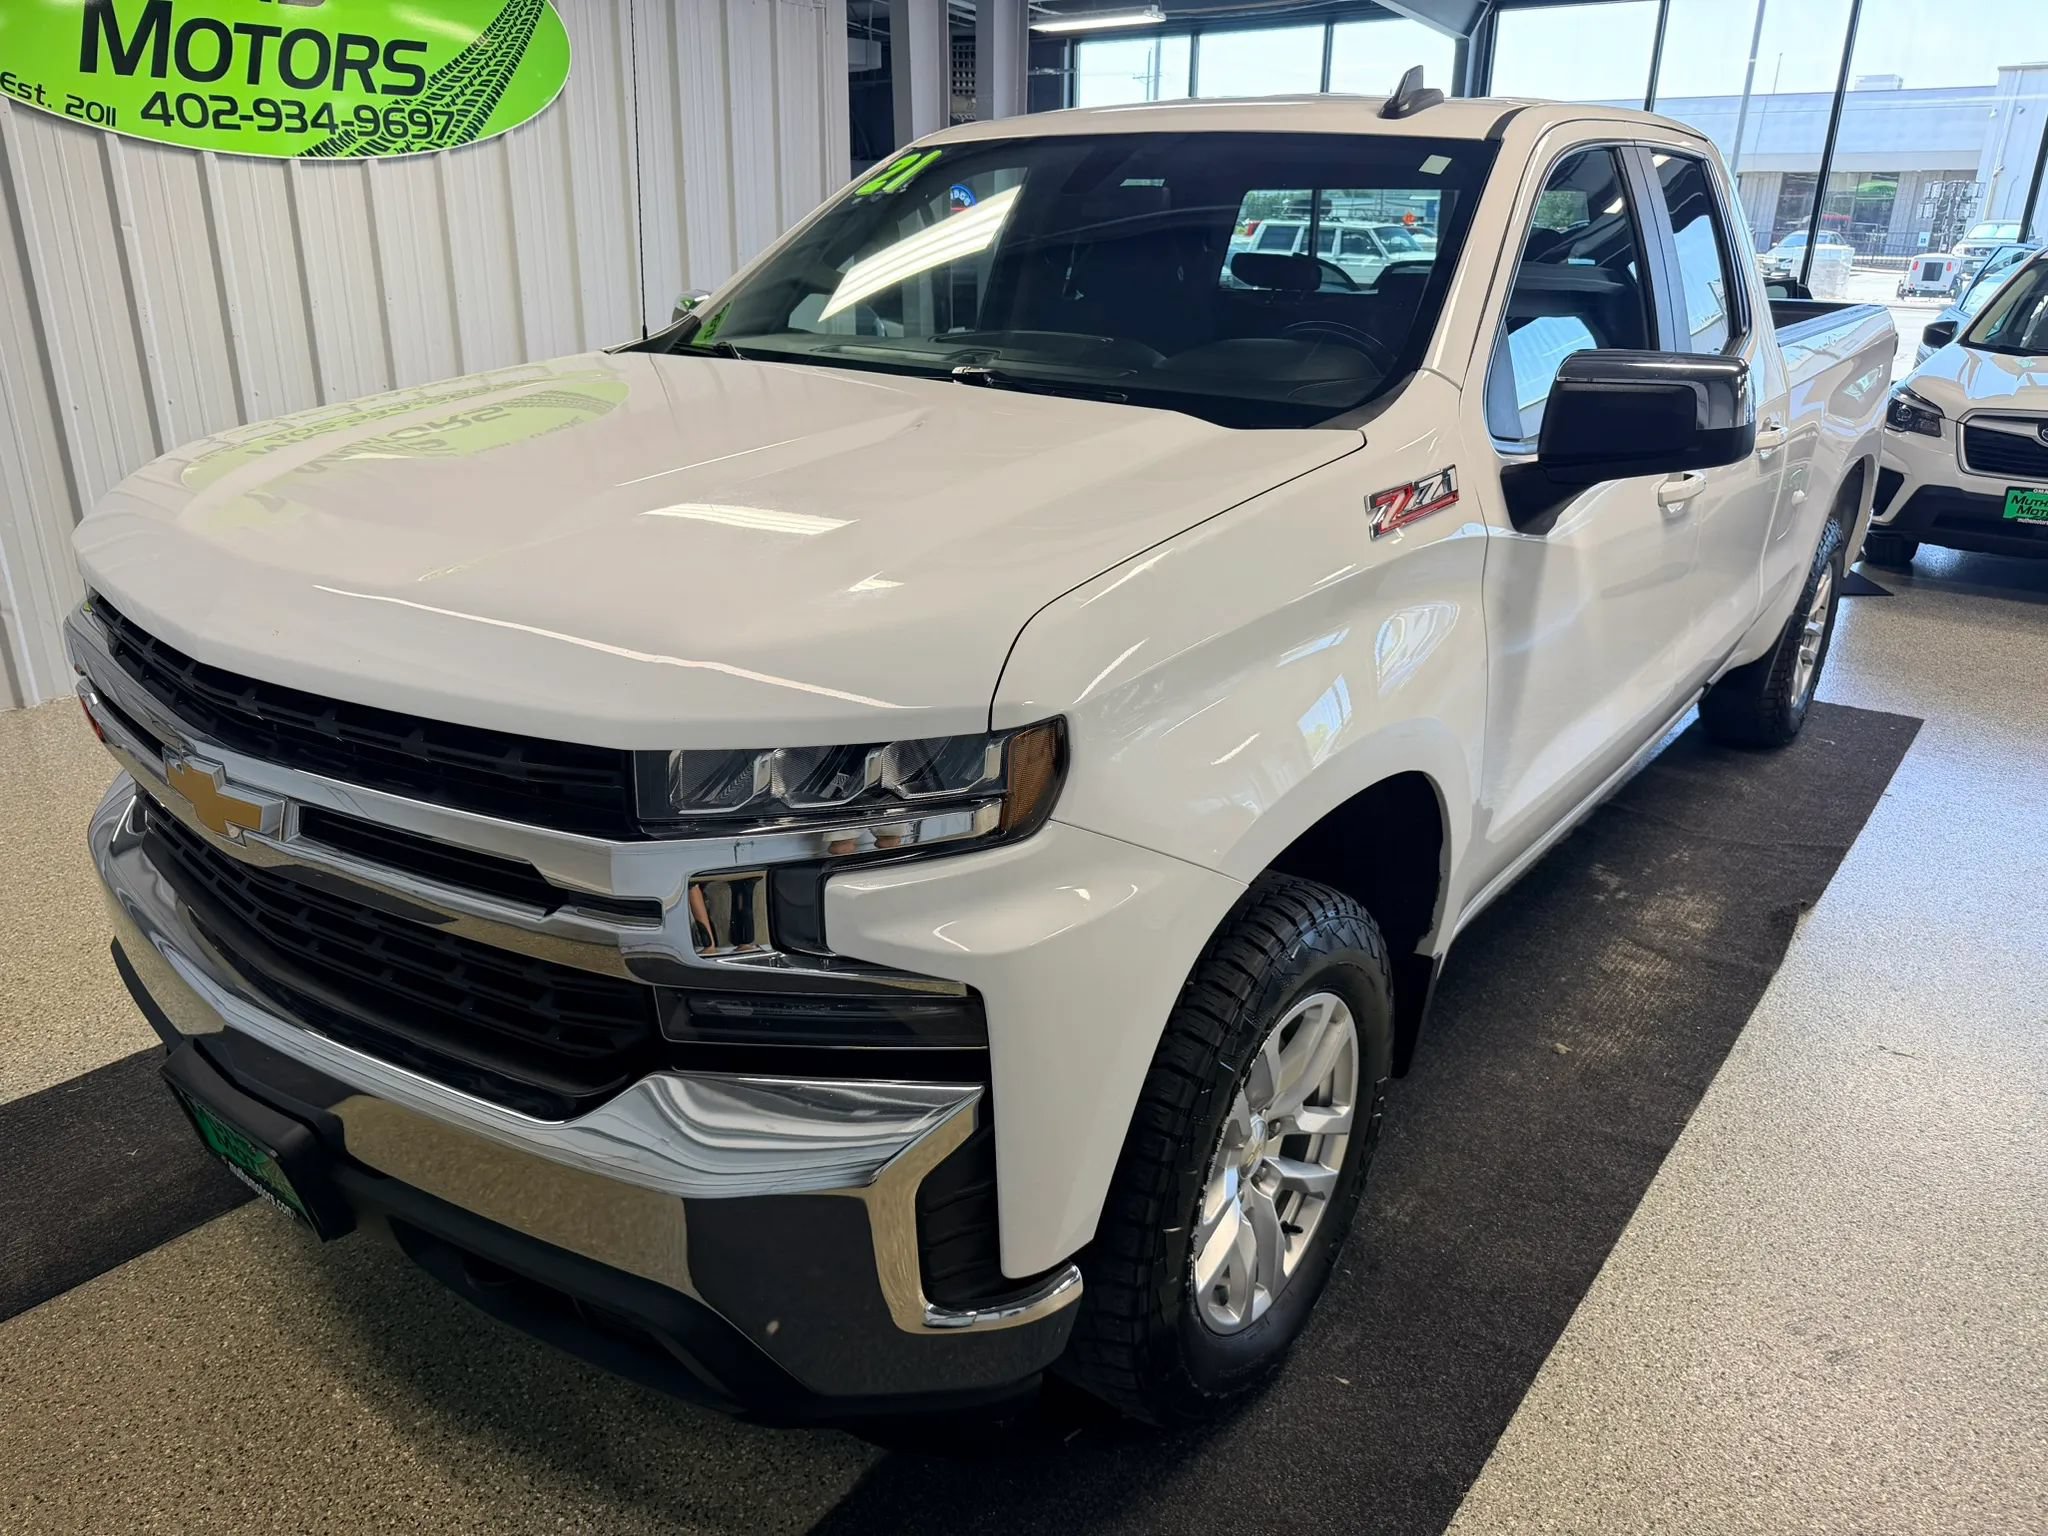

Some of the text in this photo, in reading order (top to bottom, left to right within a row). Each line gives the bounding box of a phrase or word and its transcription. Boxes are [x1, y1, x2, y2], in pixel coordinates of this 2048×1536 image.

[79, 0, 428, 96] MOTORS
[0, 71, 117, 127] Est. 2011
[140, 90, 456, 141] 402-934-9697
[1363, 464, 1460, 541] Z71
[2016, 504, 2048, 517] MOT
